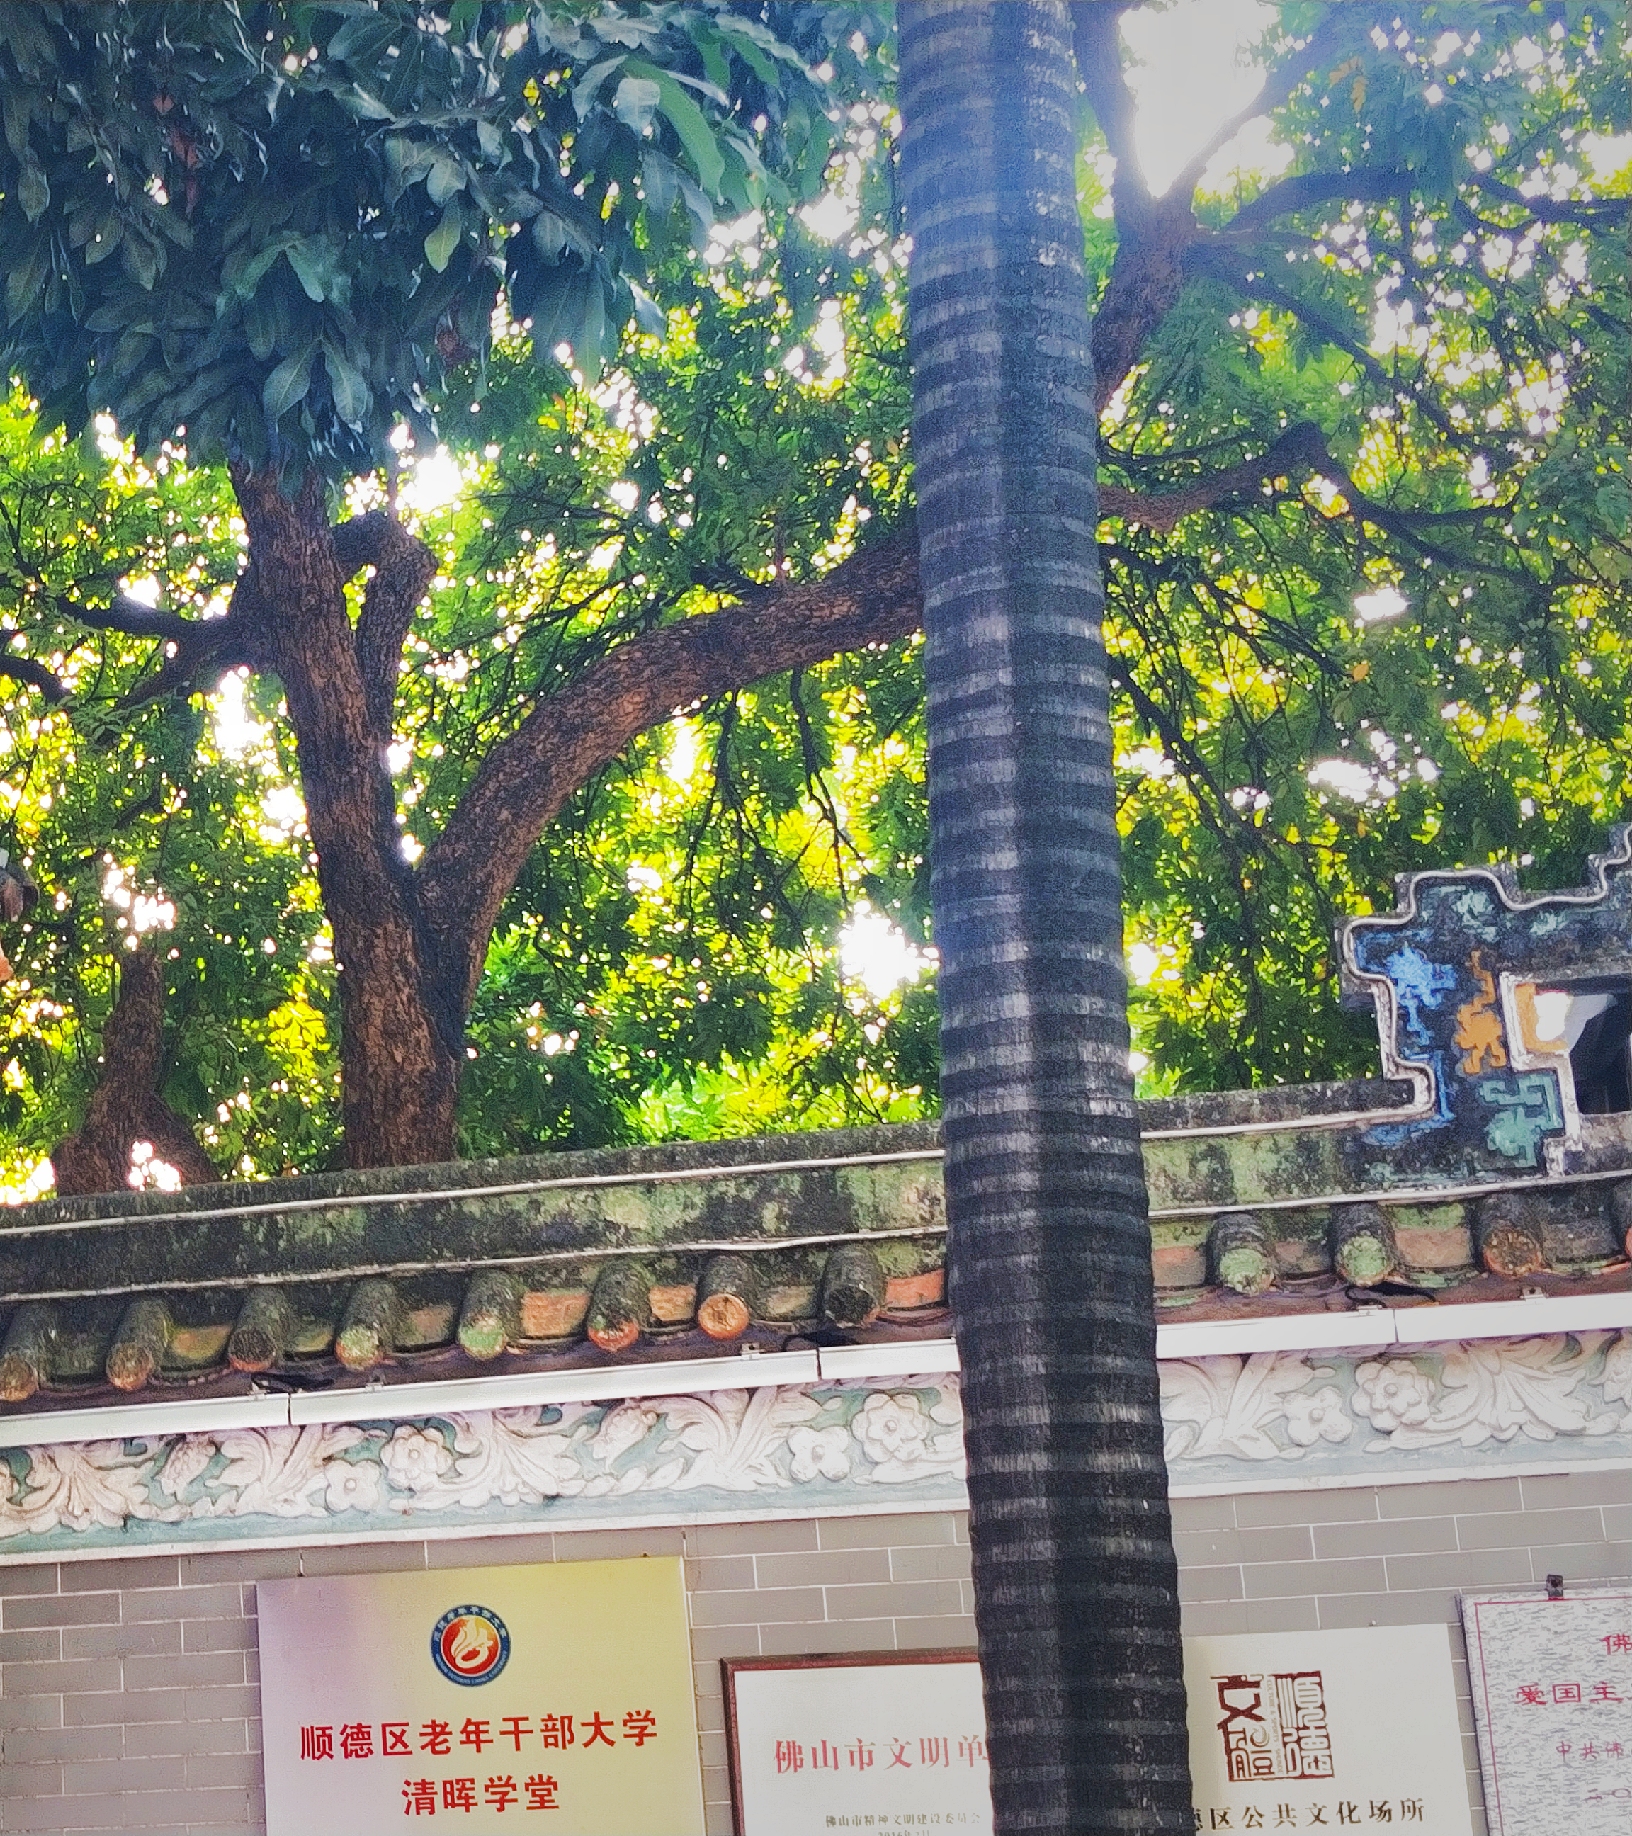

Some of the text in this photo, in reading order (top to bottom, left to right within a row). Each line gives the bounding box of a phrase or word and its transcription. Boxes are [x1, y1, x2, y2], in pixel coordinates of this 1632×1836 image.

[1602, 1633, 1632, 1656] 佛
[1515, 1682, 1624, 1706] 爱国主
[300, 1709, 658, 1760] 顺德区老年干部大学
[774, 1734, 990, 1774] 佛山市文明单
[401, 1773, 560, 1816] 清晖学堂
